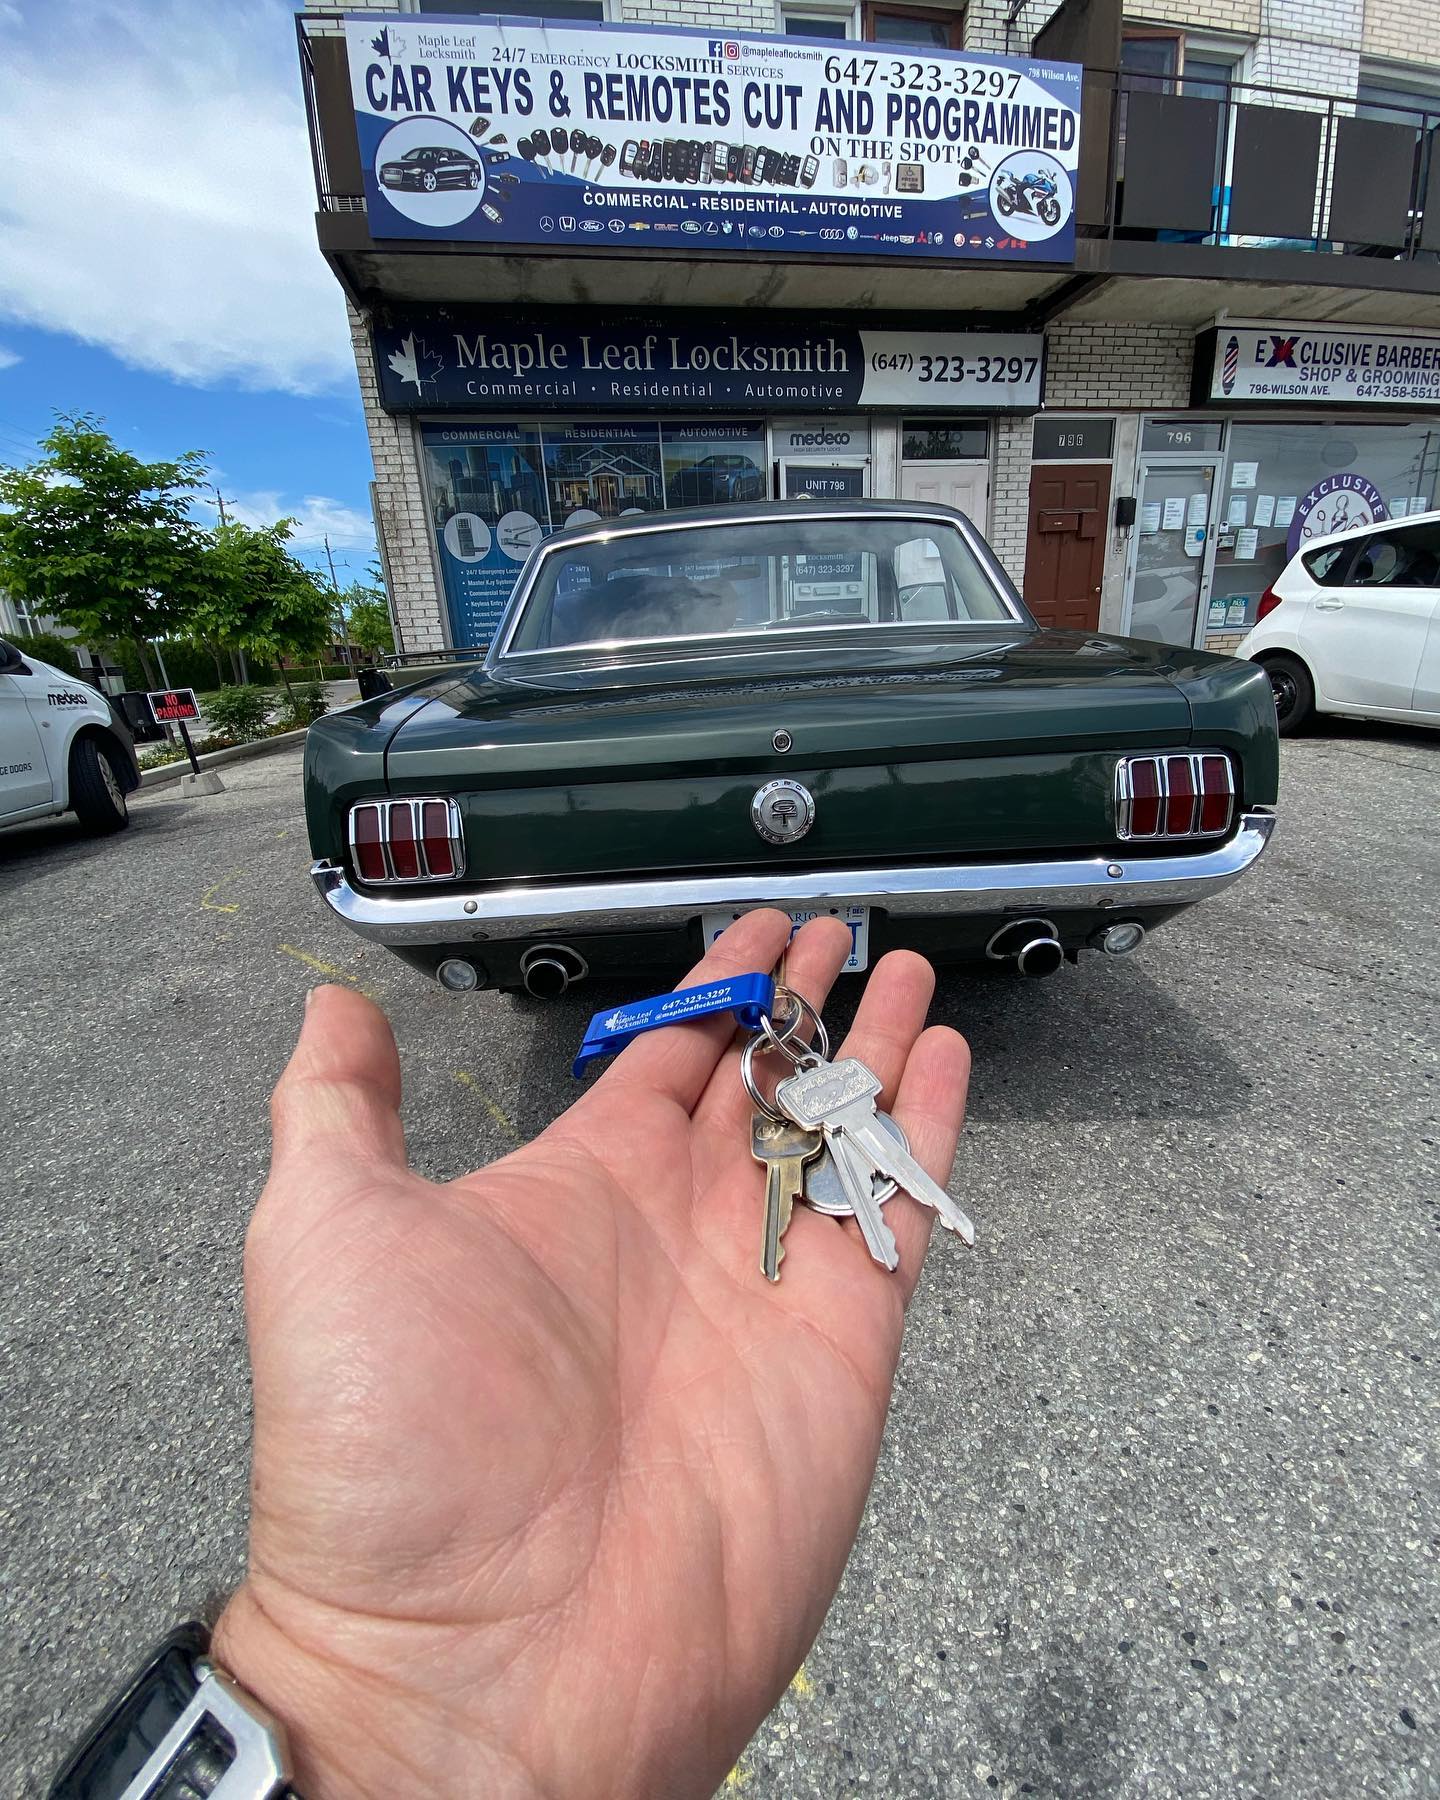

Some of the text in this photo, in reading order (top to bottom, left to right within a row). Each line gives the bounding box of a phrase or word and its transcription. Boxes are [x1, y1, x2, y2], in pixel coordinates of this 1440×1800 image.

[417, 35, 477, 48] Maple Leaf
[418, 47, 476, 60] Locksmith
[741, 45, 823, 61] @mapleleaflocksmith
[491, 46, 784, 79] 24/7 EMERGENCY LOCKSMITH SERVICES
[823, 55, 1022, 99] 647-323-3297
[1041, 68, 1065, 81] Wilson
[365, 63, 1075, 151] CAR KEYS & REMOTES CUT AND PROGRAMMED
[810, 136, 961, 164] ON THE SPOT!
[583, 191, 903, 219] COMMERCIAL RESIDENTIAL AUTOMOTIVE
[880, 233, 899, 243] Jeep
[452, 333, 850, 378] Maple Leaf Locksmith
[1255, 334, 1372, 369] EXCLUSIVE
[871, 351, 1039, 385] (647) 323-3297
[1298, 367, 1440, 387] SHOP & GROOMING
[466, 380, 844, 398] Commercial Residential Automotive
[1248, 383, 1440, 400] 796-WILSON AVE. 647-358-5511
[441, 426, 749, 441] COMMERCIAL RESIDENTIAL AUTOMOTIVE
[789, 427, 850, 446] medeco
[1058, 433, 1084, 447] 796
[1166, 431, 1192, 444] 796
[805, 480, 846, 491] UNIT 798
[1298, 475, 1384, 517] EXCLUSIVE
[478, 568, 505, 577] Emergency
[795, 563, 855, 577] (647) 323-3297
[490, 600, 503, 608] Entry
[1232, 598, 1246, 606] PASS
[472, 611, 490, 619] Access
[47, 688, 88, 706] medeco
[164, 694, 178, 706] NO
[156, 704, 196, 719] PARKING
[9, 762, 33, 774] DOORS
[762, 780, 803, 793] FORD
[661, 987, 732, 1011] 647-323-3297
[637, 1009, 653, 1020] Leaf
